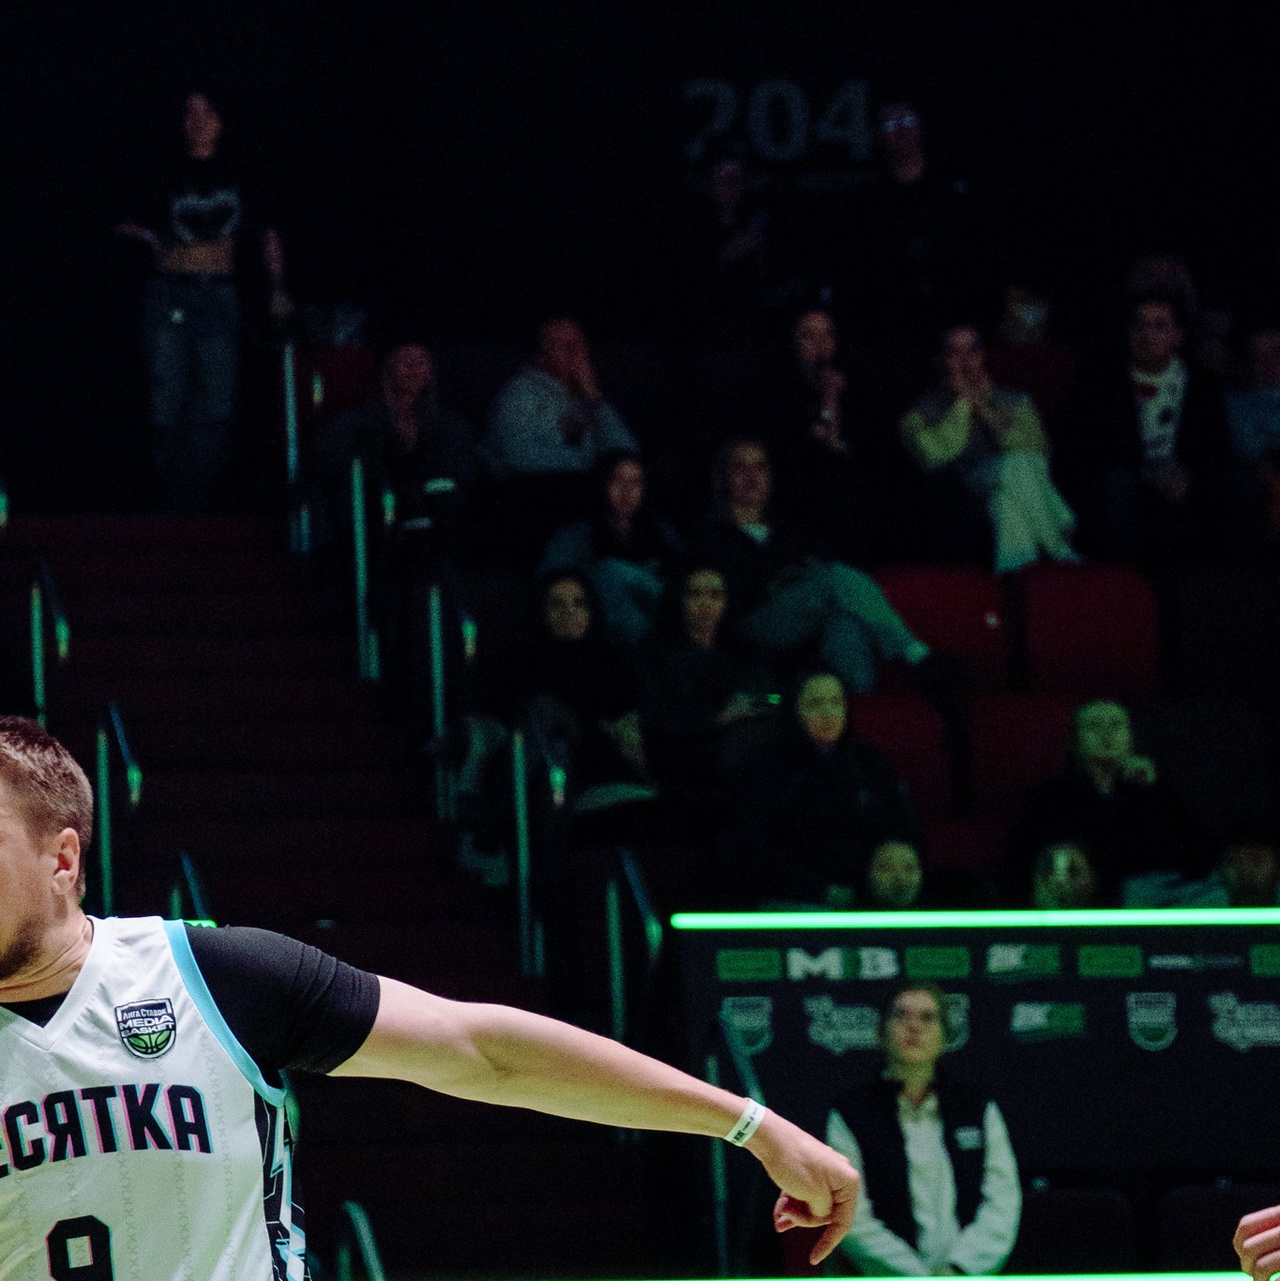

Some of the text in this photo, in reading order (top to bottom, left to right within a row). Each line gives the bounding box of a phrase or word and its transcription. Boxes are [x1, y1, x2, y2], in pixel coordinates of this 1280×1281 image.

[680, 76, 870, 161] 204
[119, 1015, 174, 1031] MEDIA
[121, 1022, 175, 1038] BASKET
